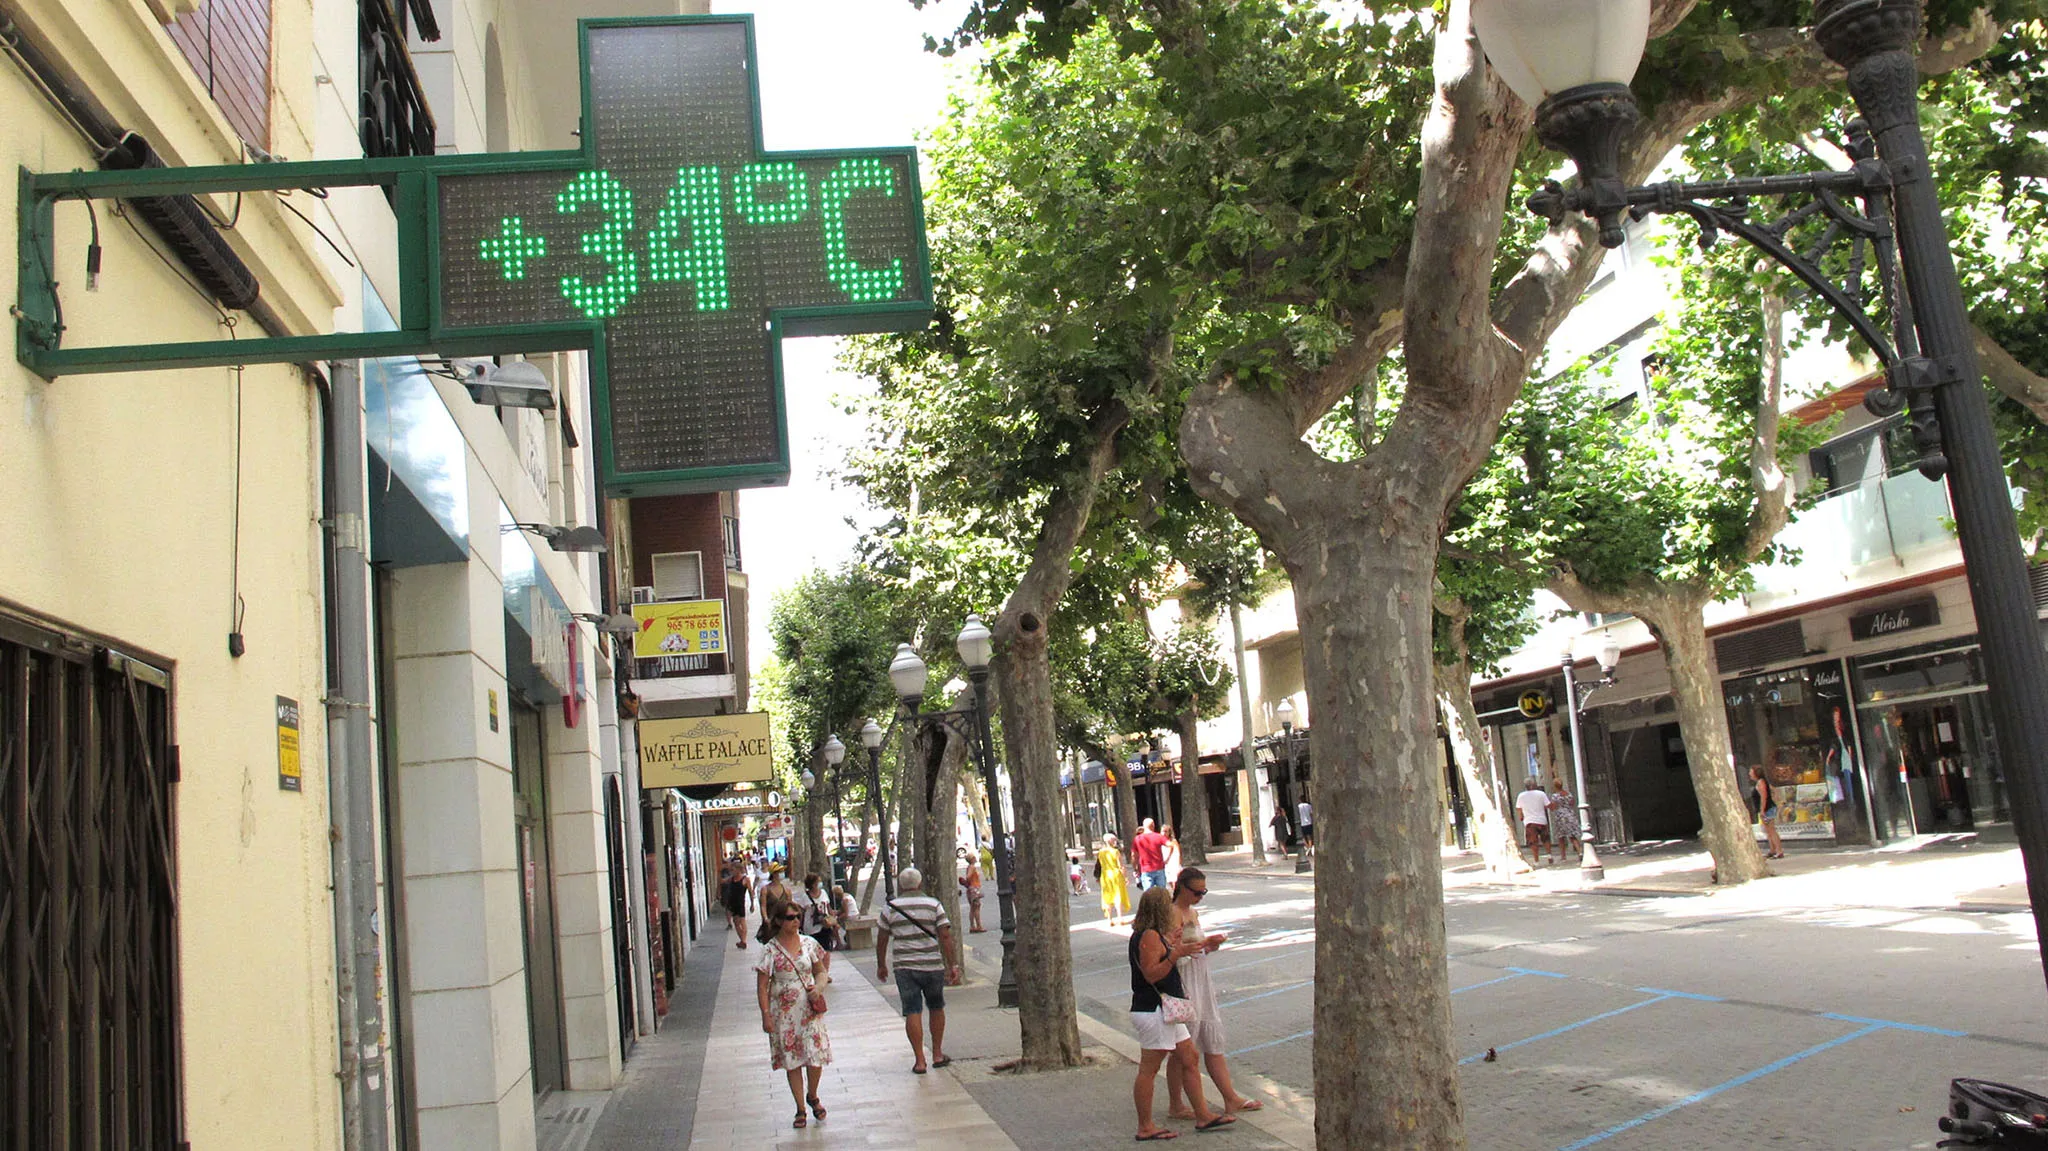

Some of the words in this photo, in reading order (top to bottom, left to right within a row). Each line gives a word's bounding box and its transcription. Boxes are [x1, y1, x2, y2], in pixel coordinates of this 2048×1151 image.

[667, 620, 682, 632] 965
[685, 619, 695, 629] 78
[697, 619, 707, 629] 65
[709, 618, 720, 628] 65
[643, 742, 704, 763] WAFFLE
[709, 739, 767, 759] PALACE
[705, 795, 760, 808] CONDADO
